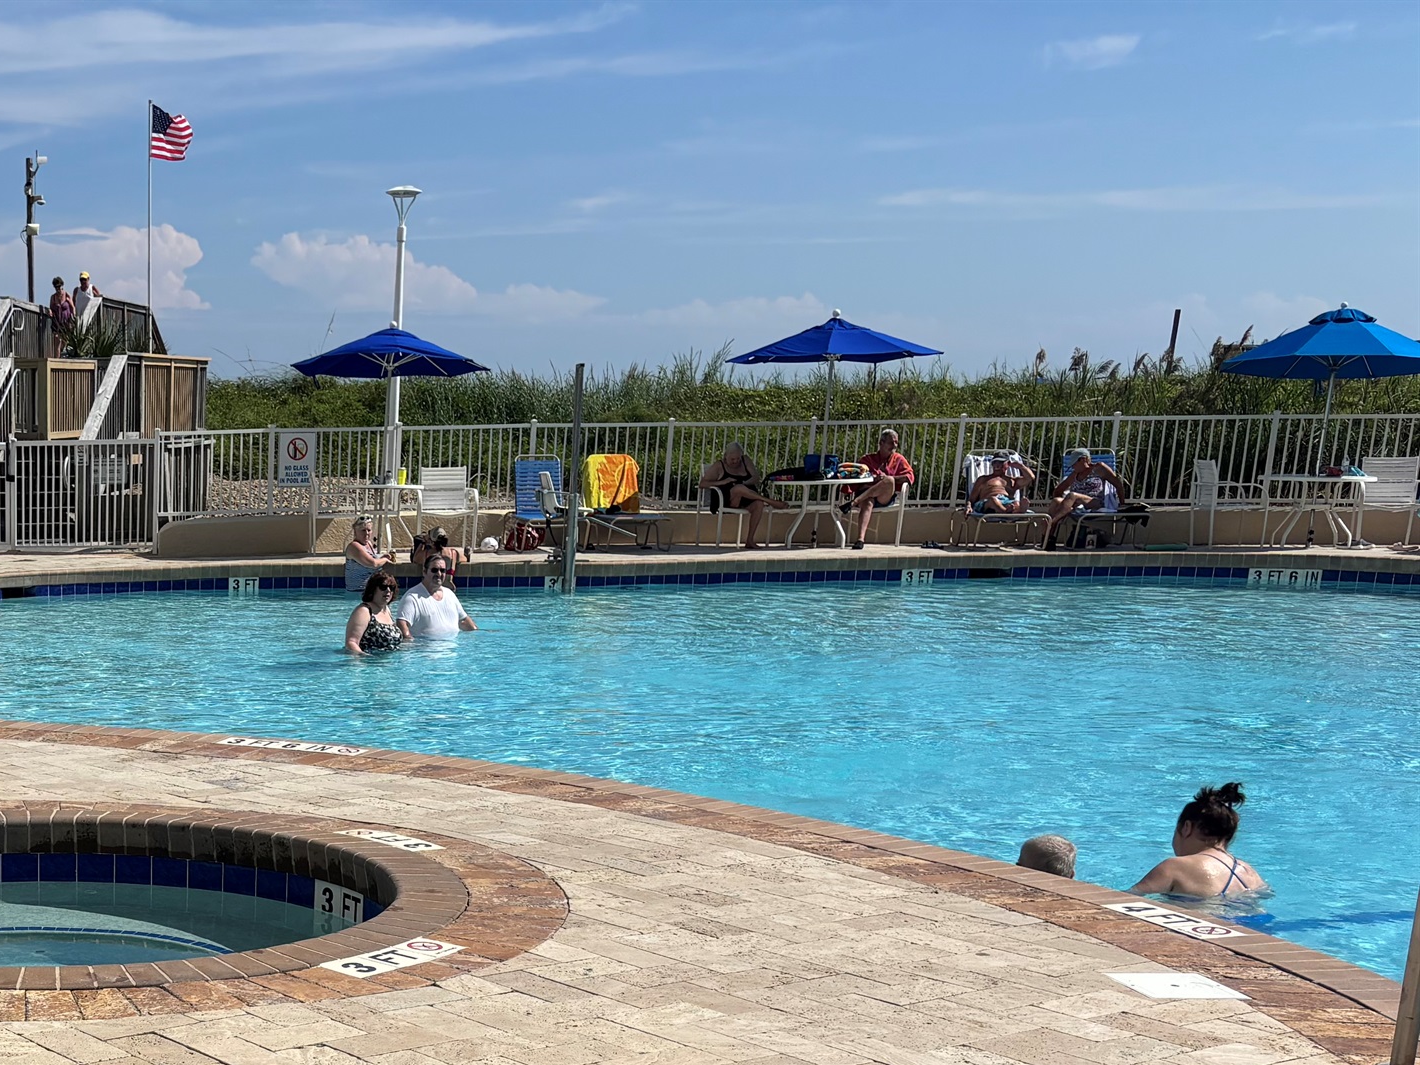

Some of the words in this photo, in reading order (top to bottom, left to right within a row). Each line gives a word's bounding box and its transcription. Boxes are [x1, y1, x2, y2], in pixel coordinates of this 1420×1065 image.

[233, 578, 240, 591] 3
[245, 578, 258, 594] FT
[905, 571, 914, 584] 3
[918, 570, 933, 584] FT
[1267, 570, 1284, 585] FT
[1288, 571, 1299, 585] 6
[1304, 571, 1320, 587] IN
[321, 886, 334, 913] 3
[342, 892, 362, 923] FT
[1121, 905, 1157, 913] 4
[1145, 913, 1202, 924] FT
[341, 962, 377, 973] 3
[368, 949, 418, 965] FT
